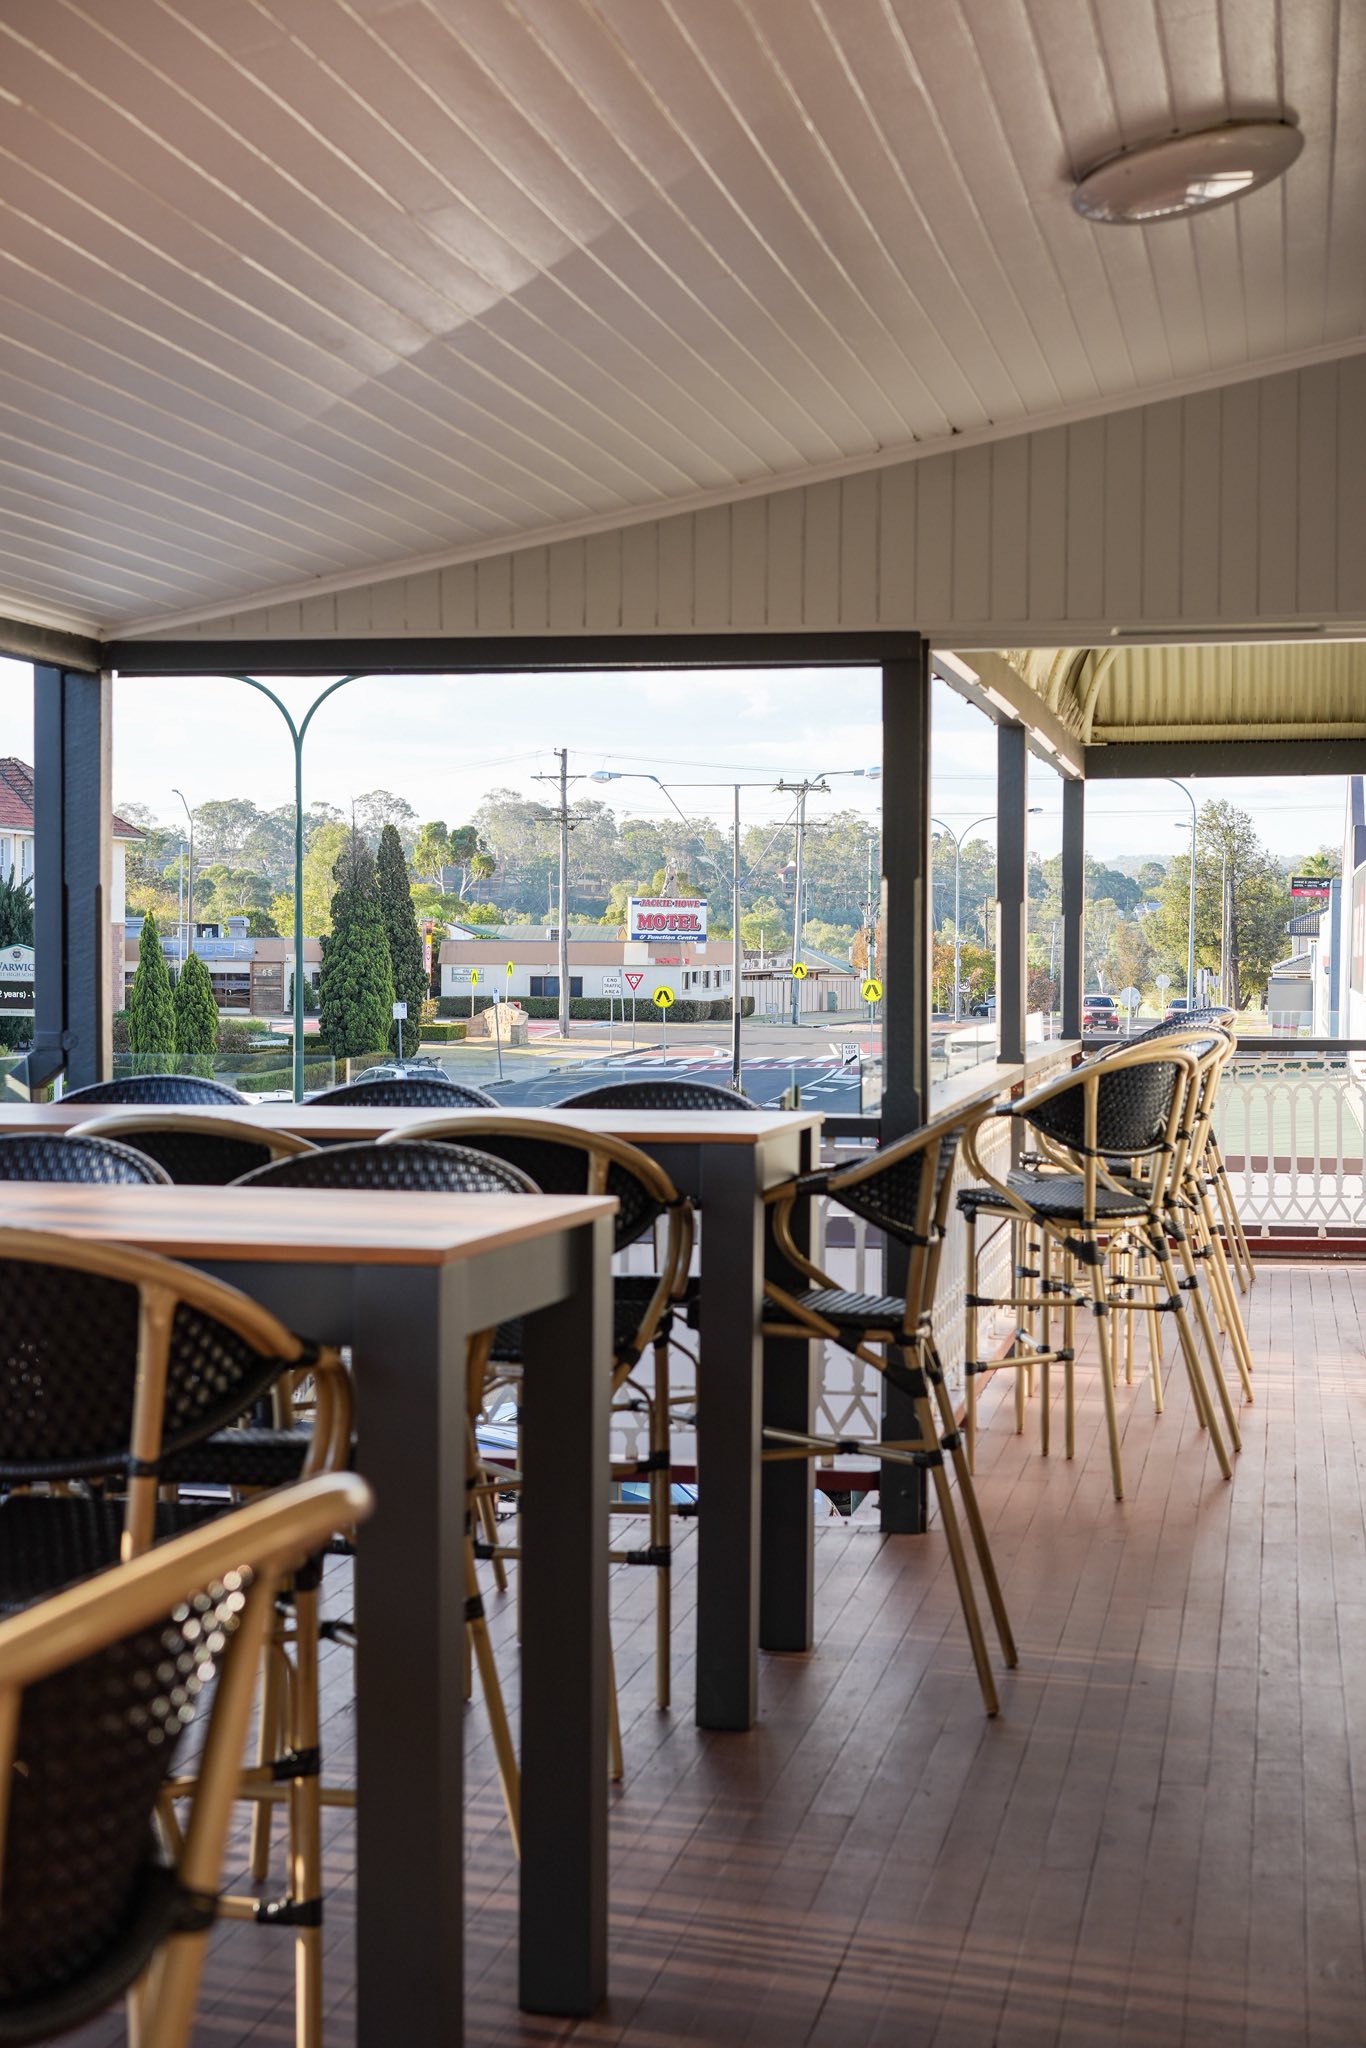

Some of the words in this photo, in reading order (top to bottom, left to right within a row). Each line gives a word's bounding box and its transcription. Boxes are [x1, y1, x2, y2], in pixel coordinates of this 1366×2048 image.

[640, 899, 672, 907] JACKIE
[675, 899, 700, 908] HOWE
[637, 913, 701, 931] MOTEL
[0, 962, 34, 971] ARWIC
[4, 991, 26, 999] years)
